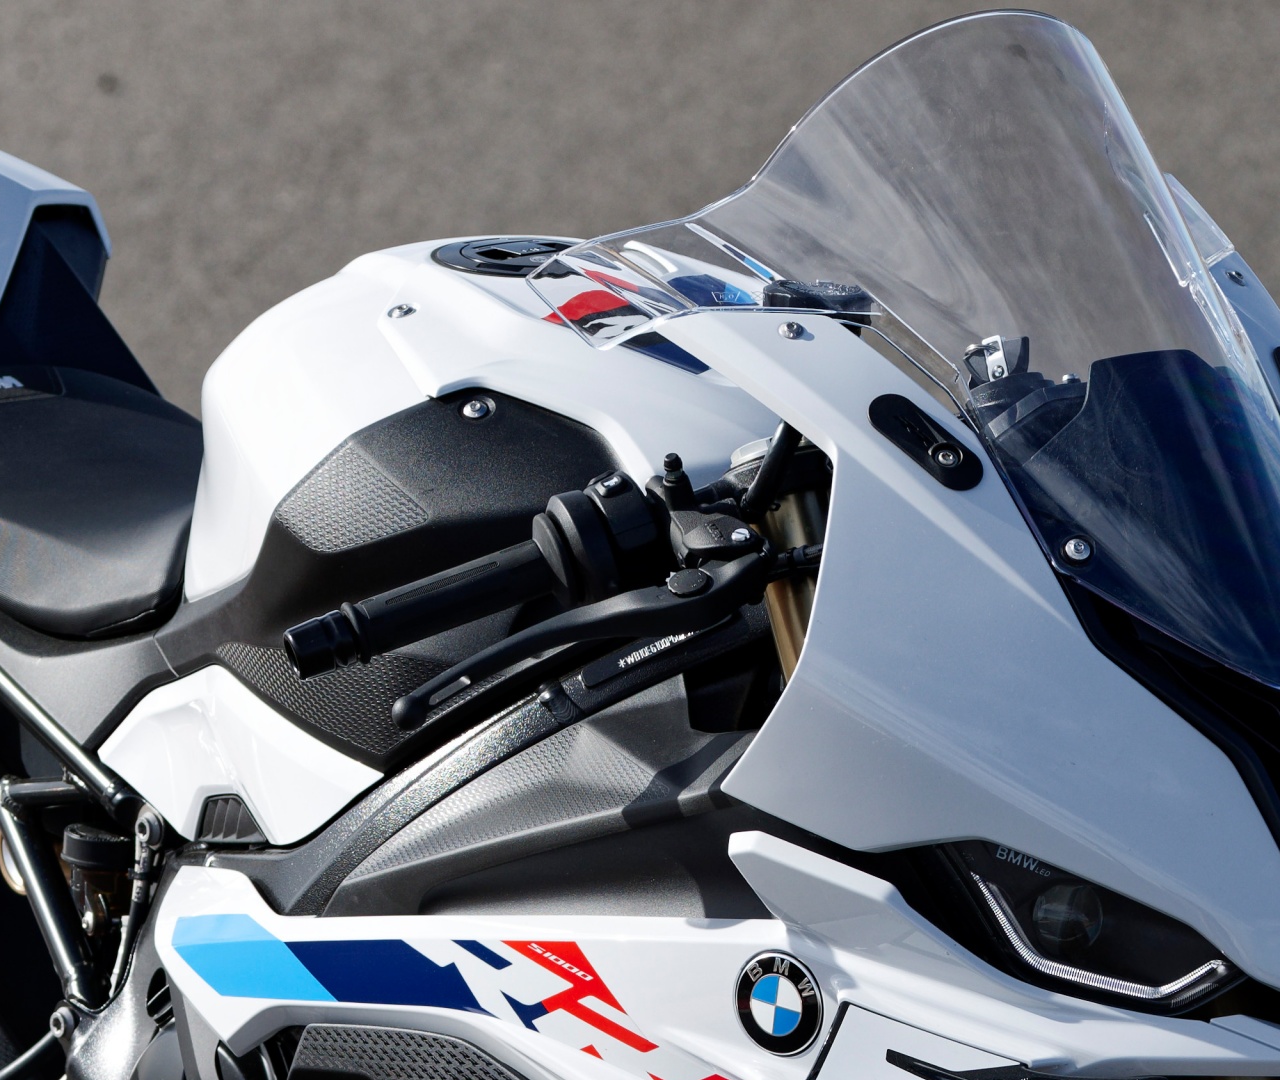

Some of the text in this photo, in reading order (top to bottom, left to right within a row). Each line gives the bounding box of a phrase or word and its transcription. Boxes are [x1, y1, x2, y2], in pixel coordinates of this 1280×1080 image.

[996, 847, 1039, 871] BMW
[527, 942, 594, 981] S1000
[747, 957, 815, 998] BMW
